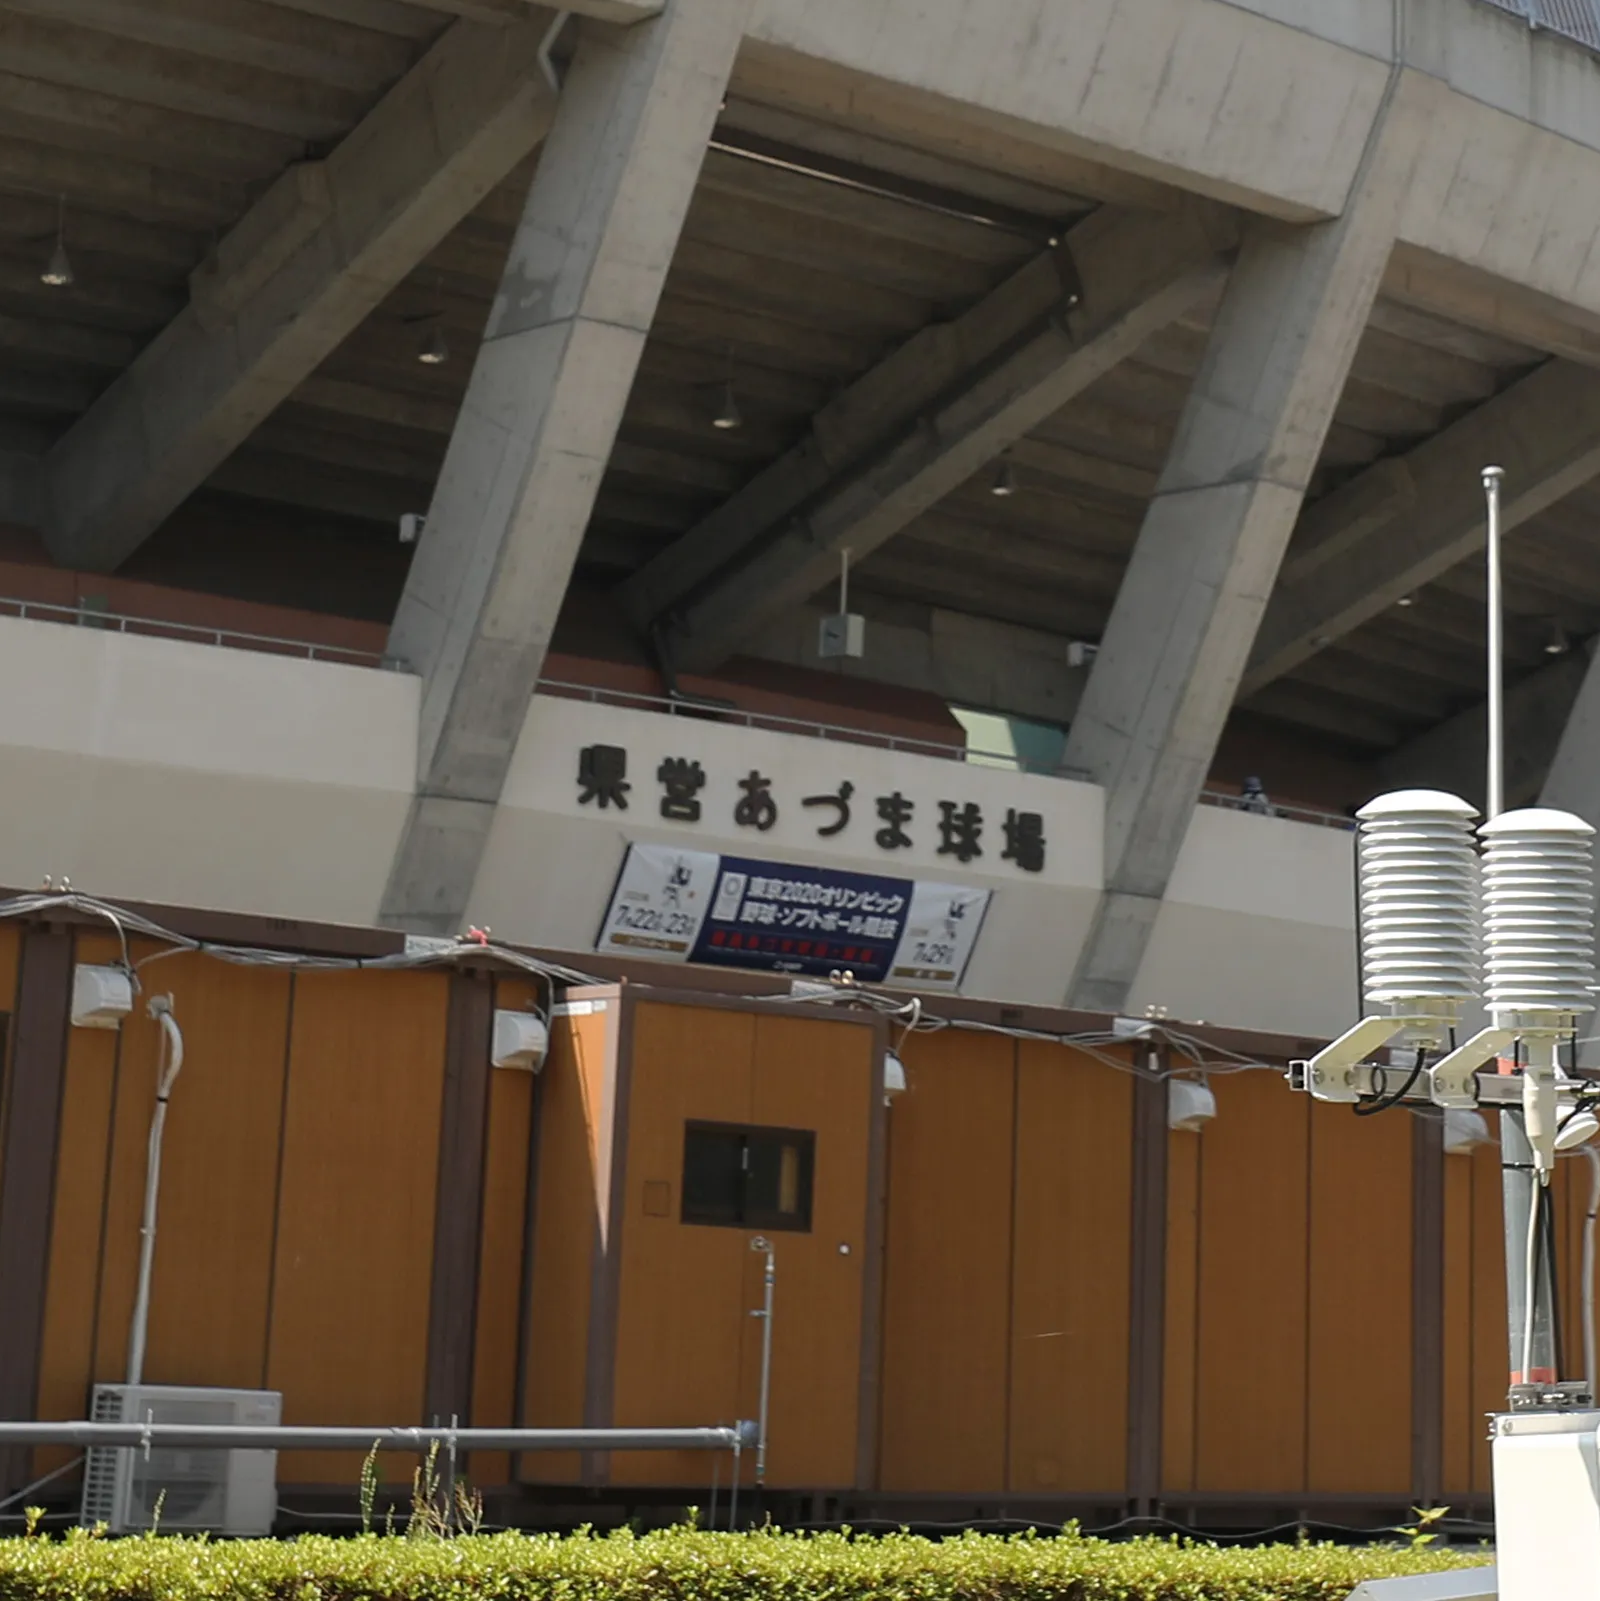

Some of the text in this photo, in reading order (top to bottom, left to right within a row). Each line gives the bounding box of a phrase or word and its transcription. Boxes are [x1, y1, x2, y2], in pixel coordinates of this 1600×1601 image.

[577, 743, 1047, 873] 県営あづま球場
[746, 876, 905, 915] 東京2020オリンピック
